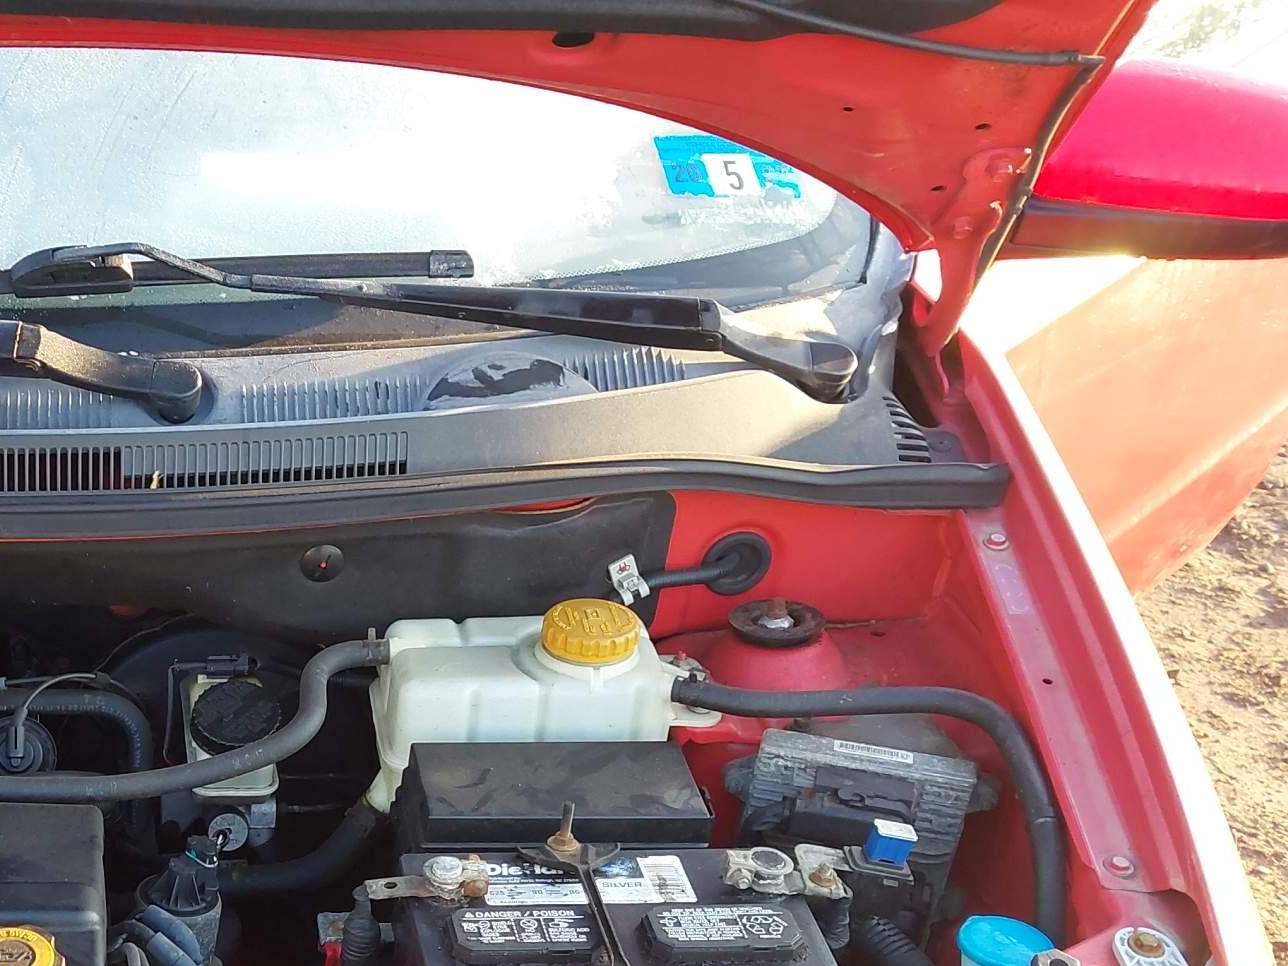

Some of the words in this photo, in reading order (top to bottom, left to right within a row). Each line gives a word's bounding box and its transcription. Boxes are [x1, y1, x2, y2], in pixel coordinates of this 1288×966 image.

[722, 160, 745, 190] 5
[601, 880, 643, 889] SILVER
[475, 910, 522, 918] DANGER
